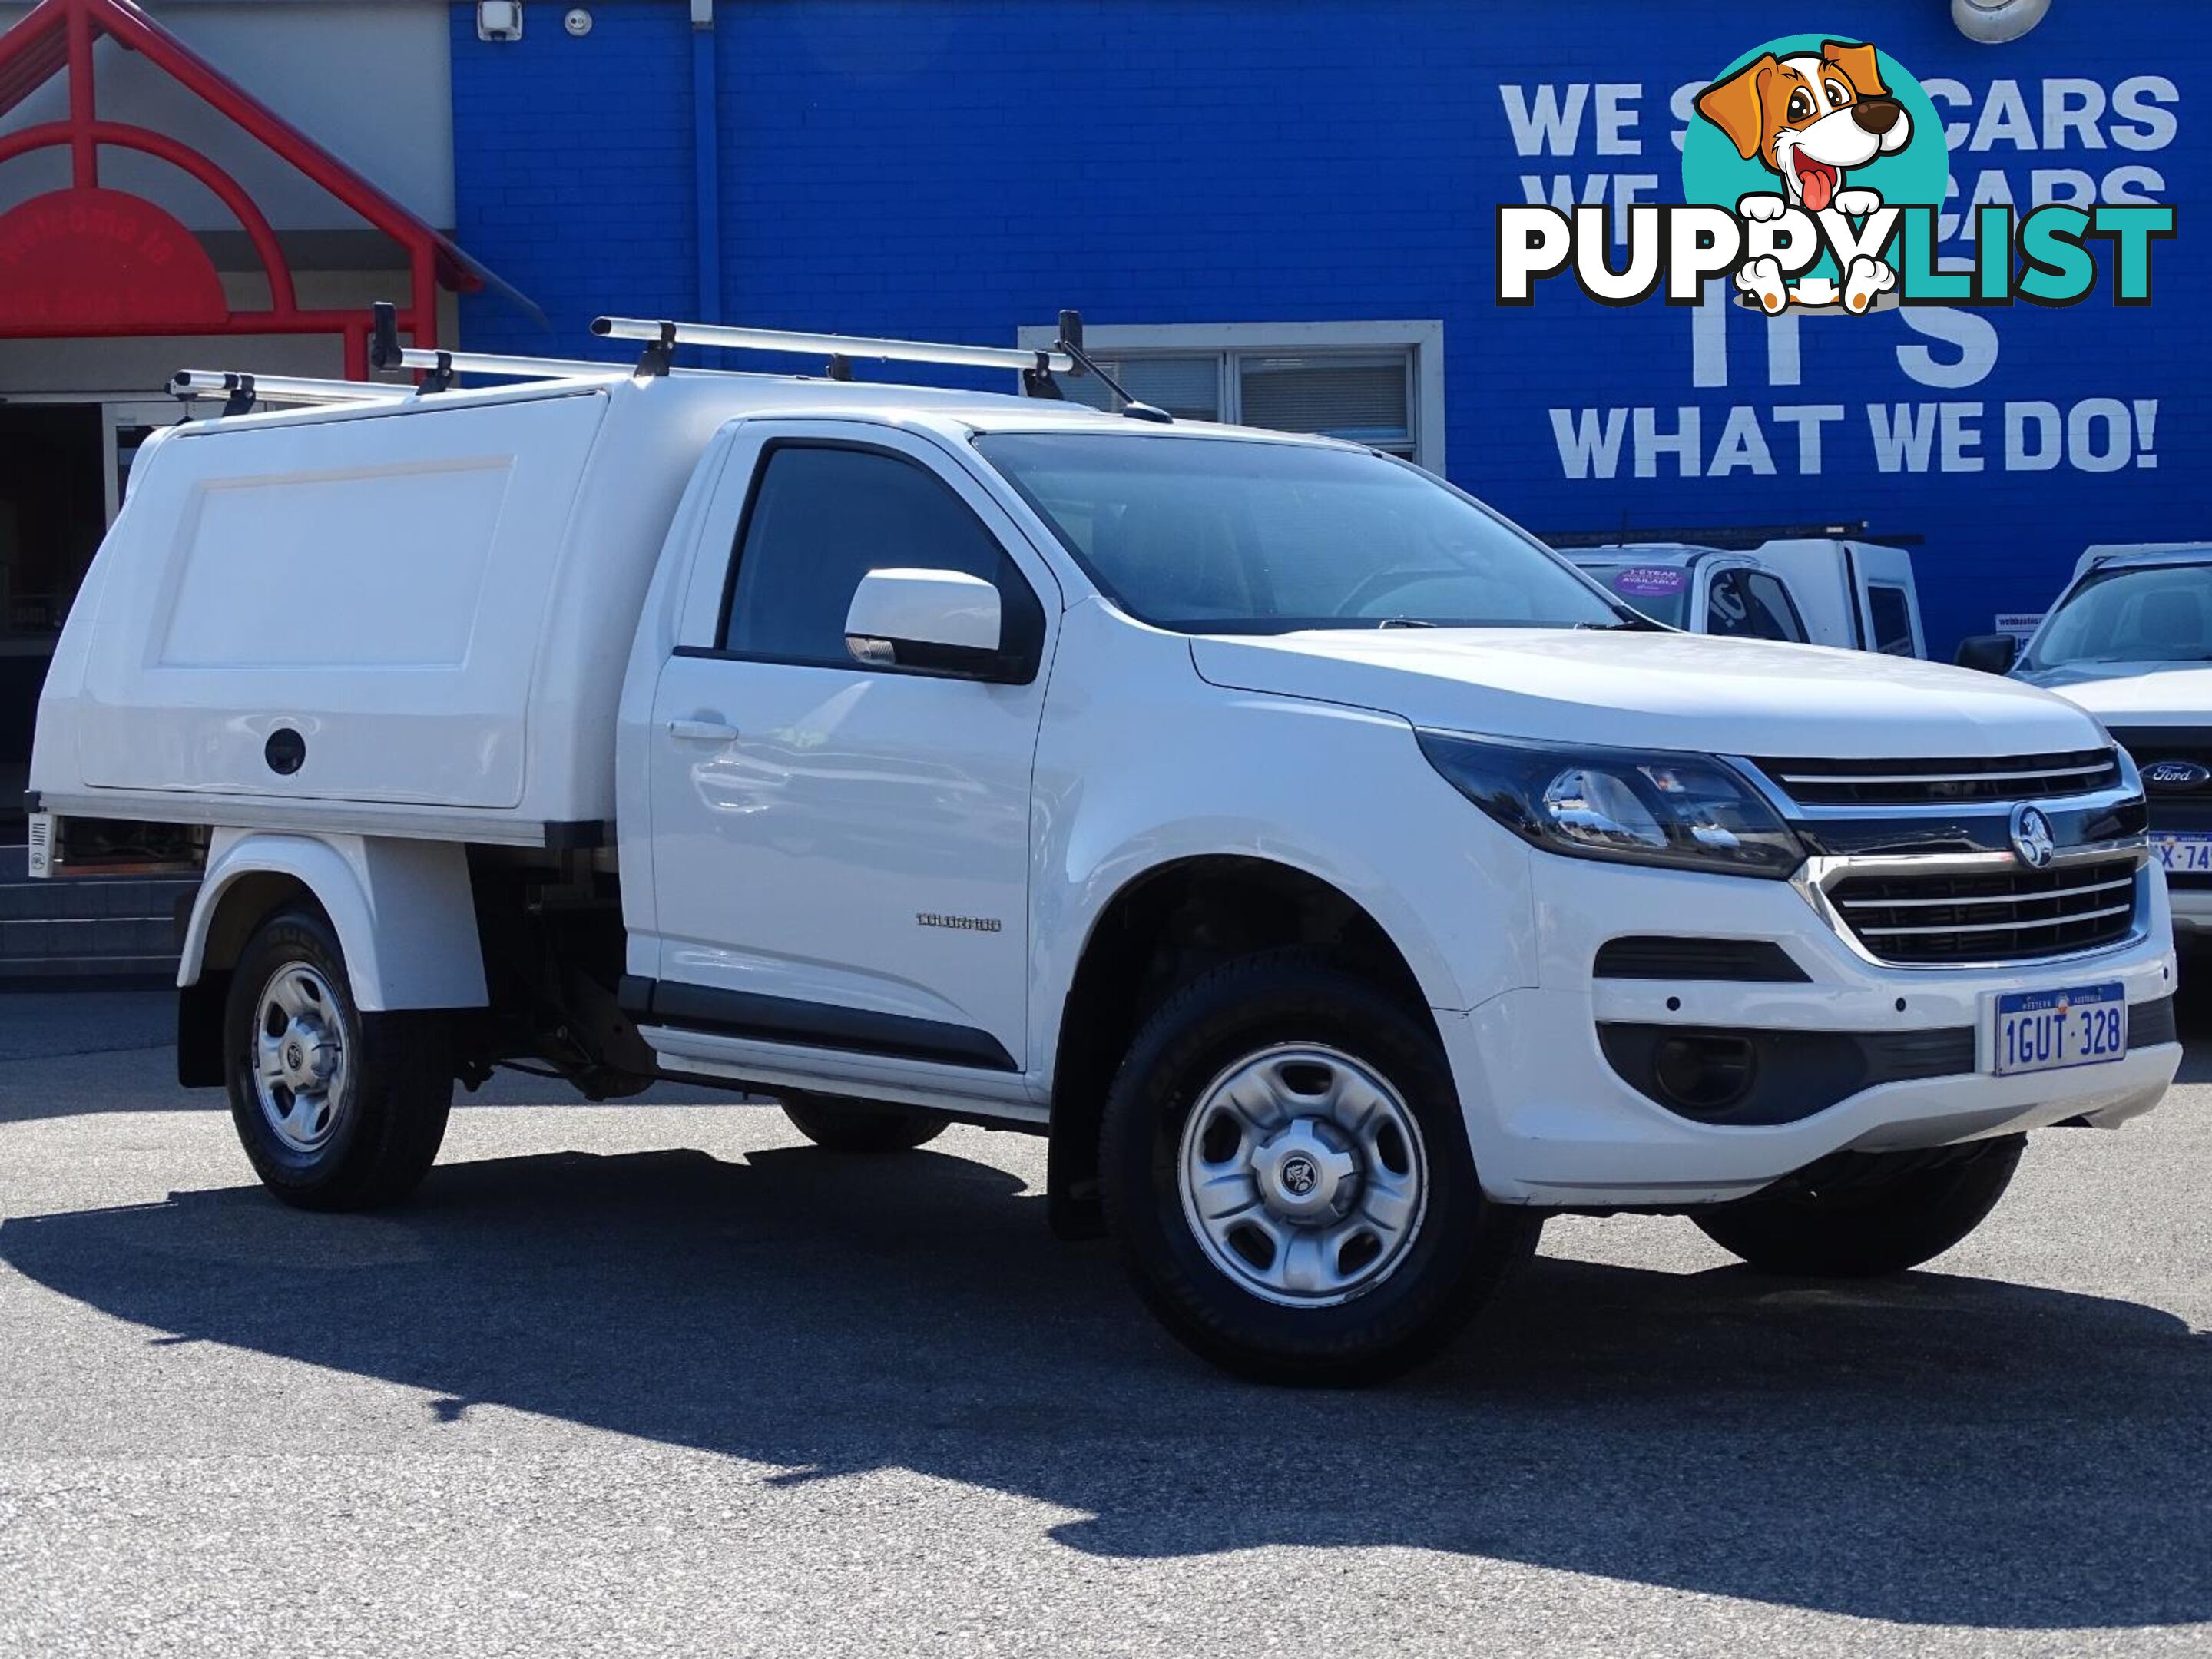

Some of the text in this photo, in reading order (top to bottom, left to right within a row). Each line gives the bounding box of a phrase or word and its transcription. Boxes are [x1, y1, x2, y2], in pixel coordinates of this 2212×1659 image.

[1499, 84, 1643, 156] WE
[1919, 75, 2180, 151] CARS
[1692, 257, 1998, 389] IS
[1548, 397, 2158, 479] WHAT WE DO!
[2153, 765, 2193, 781] Ford
